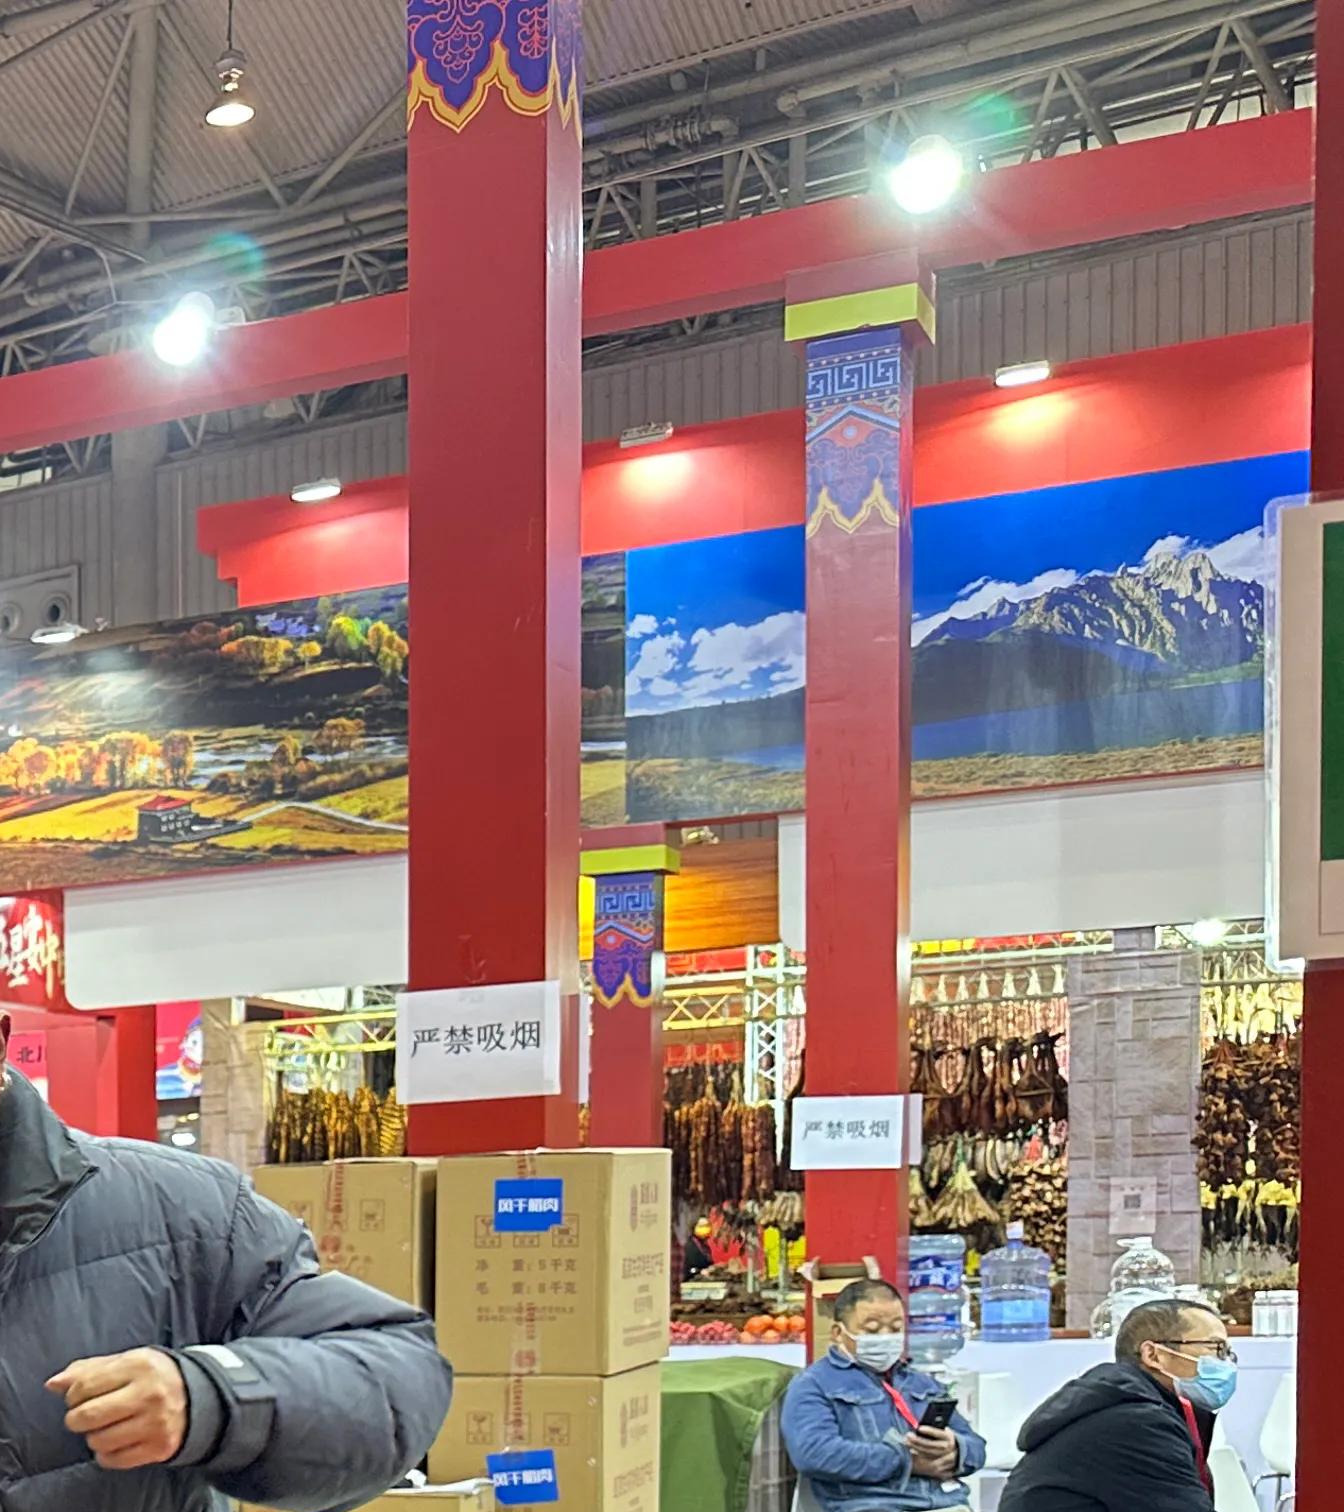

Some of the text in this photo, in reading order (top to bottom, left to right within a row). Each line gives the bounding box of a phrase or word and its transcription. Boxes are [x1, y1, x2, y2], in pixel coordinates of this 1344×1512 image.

[411, 1020, 541, 1058] 严禁吸烟
[802, 1118, 890, 1140] 严禁吸烟
[497, 1197, 559, 1213] 风干腊肉
[493, 1468, 554, 1487] 风干腊肉
